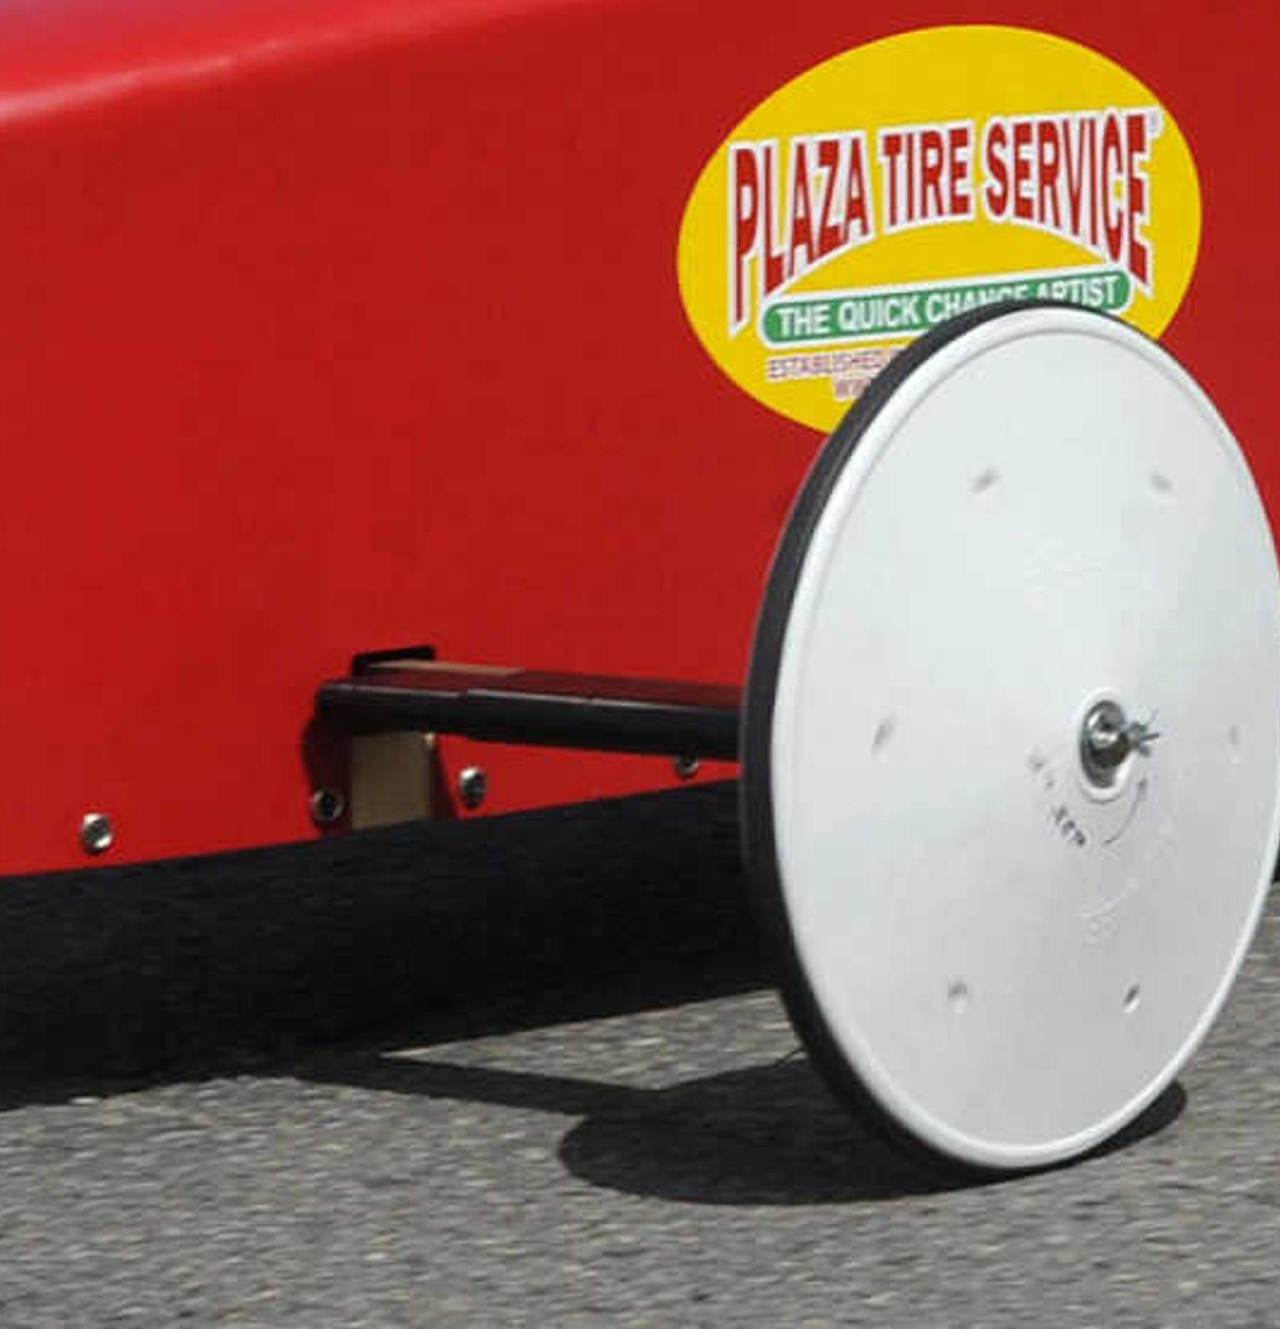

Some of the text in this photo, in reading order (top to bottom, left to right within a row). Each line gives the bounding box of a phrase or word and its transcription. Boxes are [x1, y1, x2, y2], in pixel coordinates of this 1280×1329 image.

[734, 113, 1149, 324] PLAZA TIRE SERVICE
[776, 303, 832, 337] THE
[837, 294, 920, 332] QUICK
